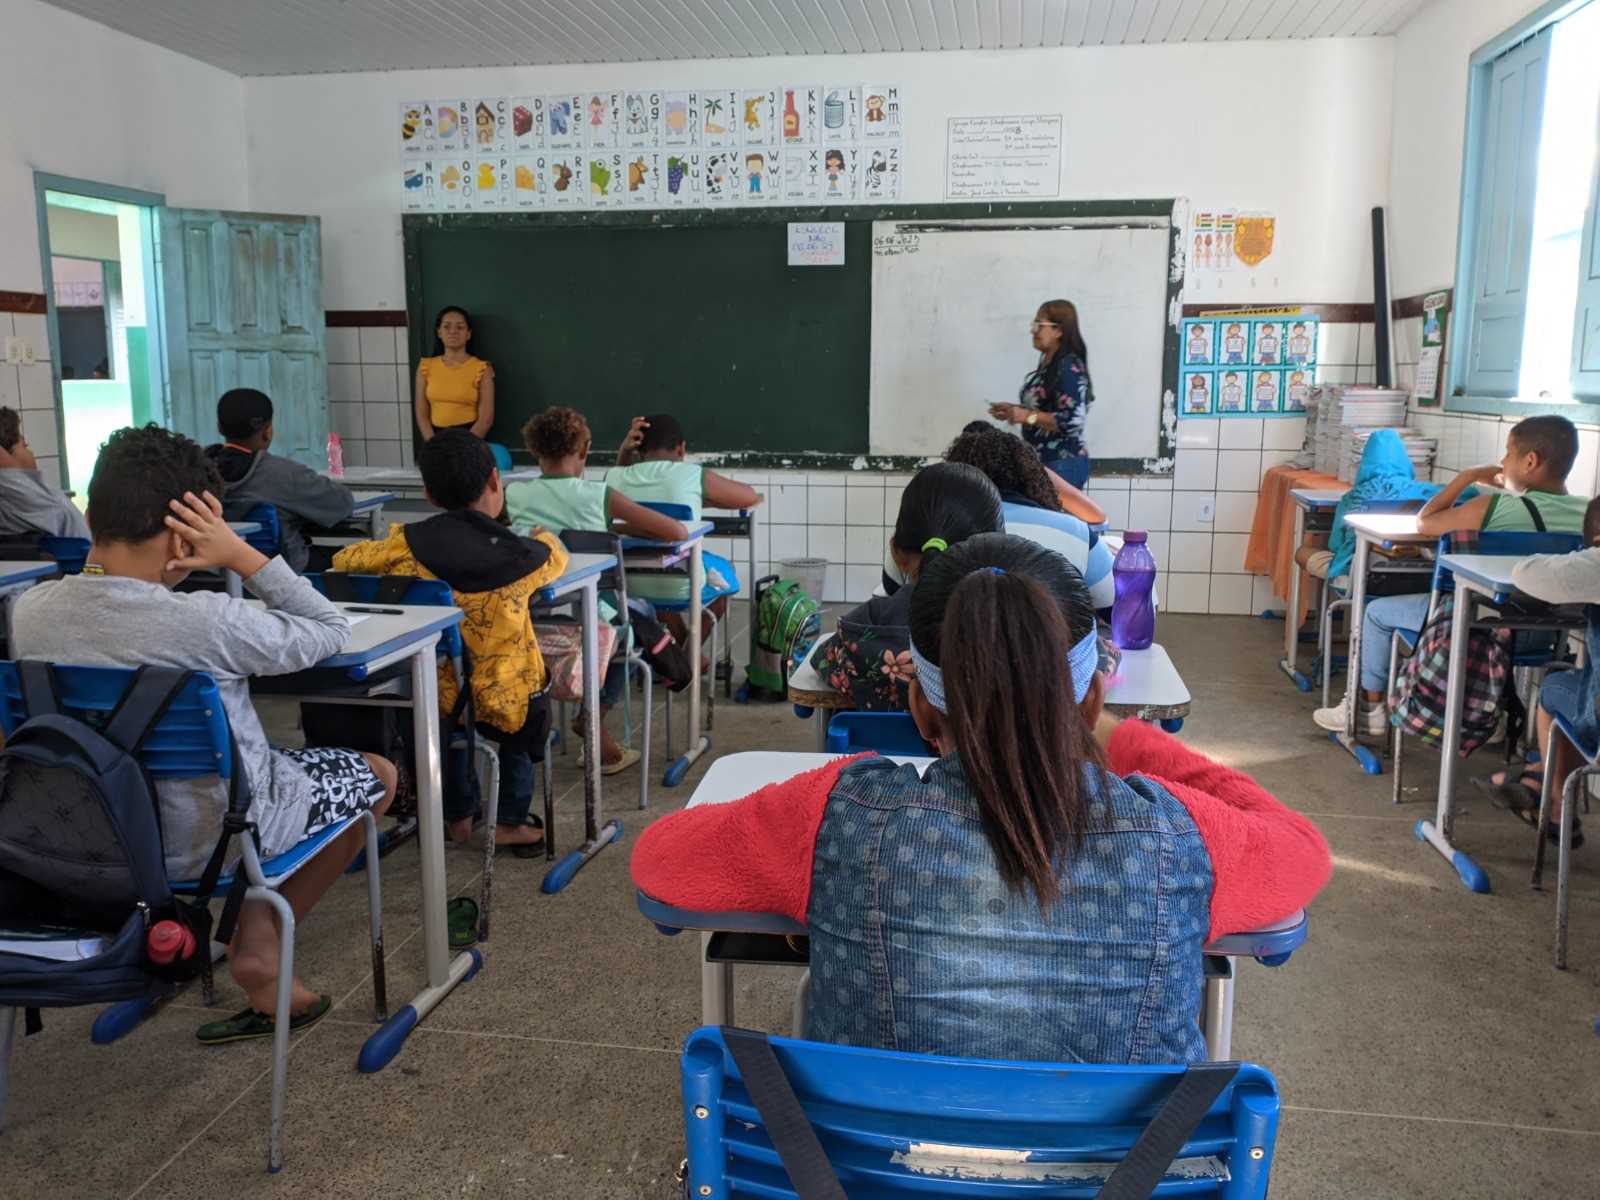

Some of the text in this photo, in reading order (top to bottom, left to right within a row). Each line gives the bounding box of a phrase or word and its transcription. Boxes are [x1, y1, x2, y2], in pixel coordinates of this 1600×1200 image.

[768, 92, 774, 103] J
[808, 90, 816, 102] K
[850, 90, 856, 100] L
[889, 88, 897, 98] M
[573, 97, 580, 108] E
[612, 95, 617, 106] F
[650, 94, 660, 105] G
[689, 94, 696, 104] H
[424, 104, 432, 114] A
[460, 102, 467, 112] B
[497, 101, 504, 112] C
[535, 99, 542, 110] D
[652, 154, 658, 164] T
[730, 152, 738, 162] V
[768, 152, 779, 162] W
[809, 150, 817, 160] X
[890, 149, 898, 159] Z
[500, 159, 506, 169] P
[537, 158, 545, 168] Q
[576, 156, 582, 167] R
[614, 155, 620, 166] S
[691, 154, 698, 165] U
[426, 160, 432, 172] N
[462, 160, 470, 171] O
